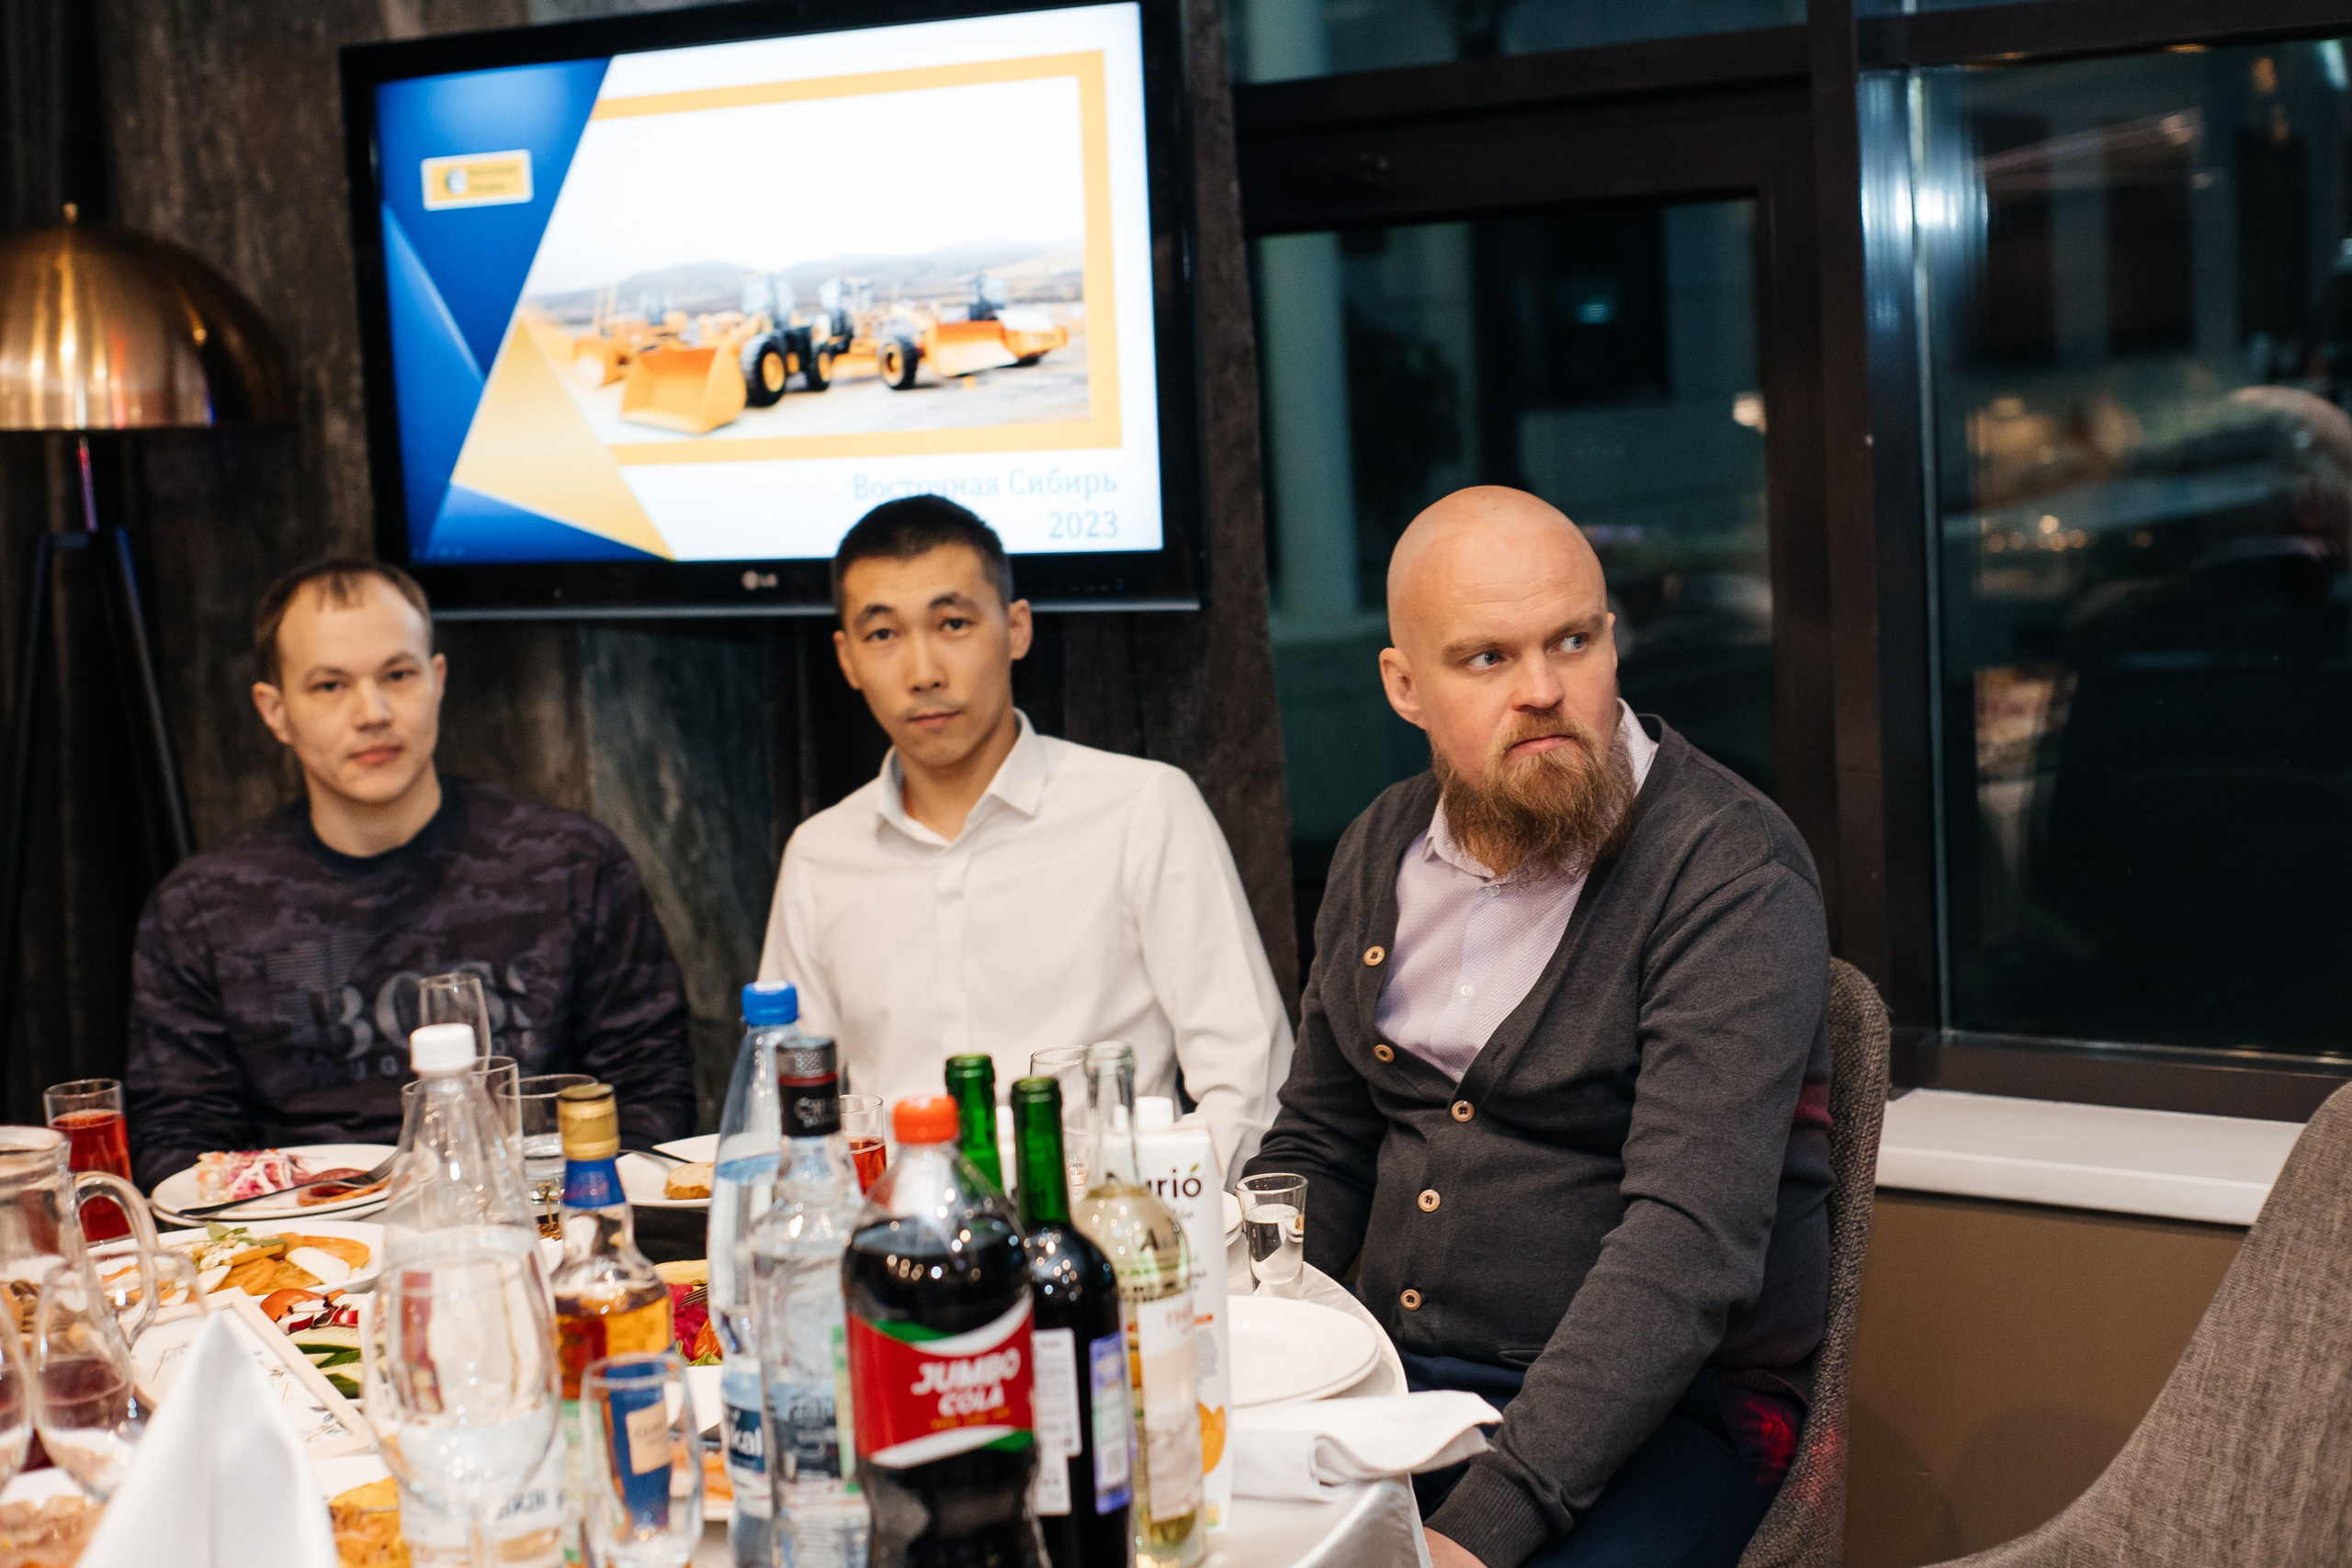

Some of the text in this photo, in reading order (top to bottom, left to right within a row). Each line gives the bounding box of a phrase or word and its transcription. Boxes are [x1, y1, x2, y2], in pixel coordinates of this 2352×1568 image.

[853, 468, 1118, 501] Восточная Сибирь
[1047, 510, 1118, 539] 2023
[910, 1346, 1022, 1396] JUMBO
[937, 1382, 1006, 1417] COLA
